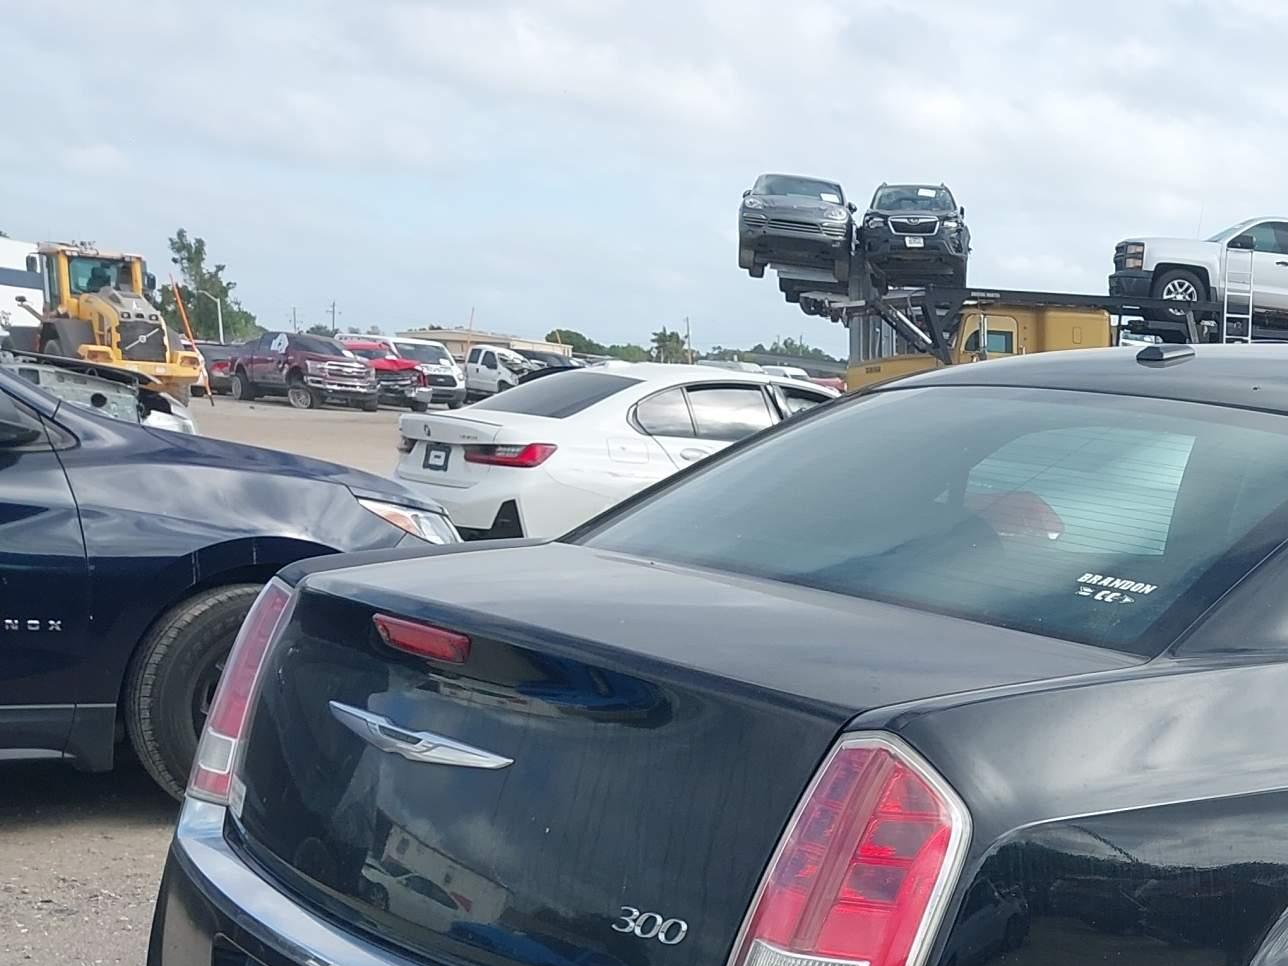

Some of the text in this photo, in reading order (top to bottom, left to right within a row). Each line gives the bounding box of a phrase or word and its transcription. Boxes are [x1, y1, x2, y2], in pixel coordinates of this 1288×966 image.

[1077, 572, 1159, 595] BRANDON
[4, 619, 62, 631] NOX
[611, 906, 688, 945] 300
